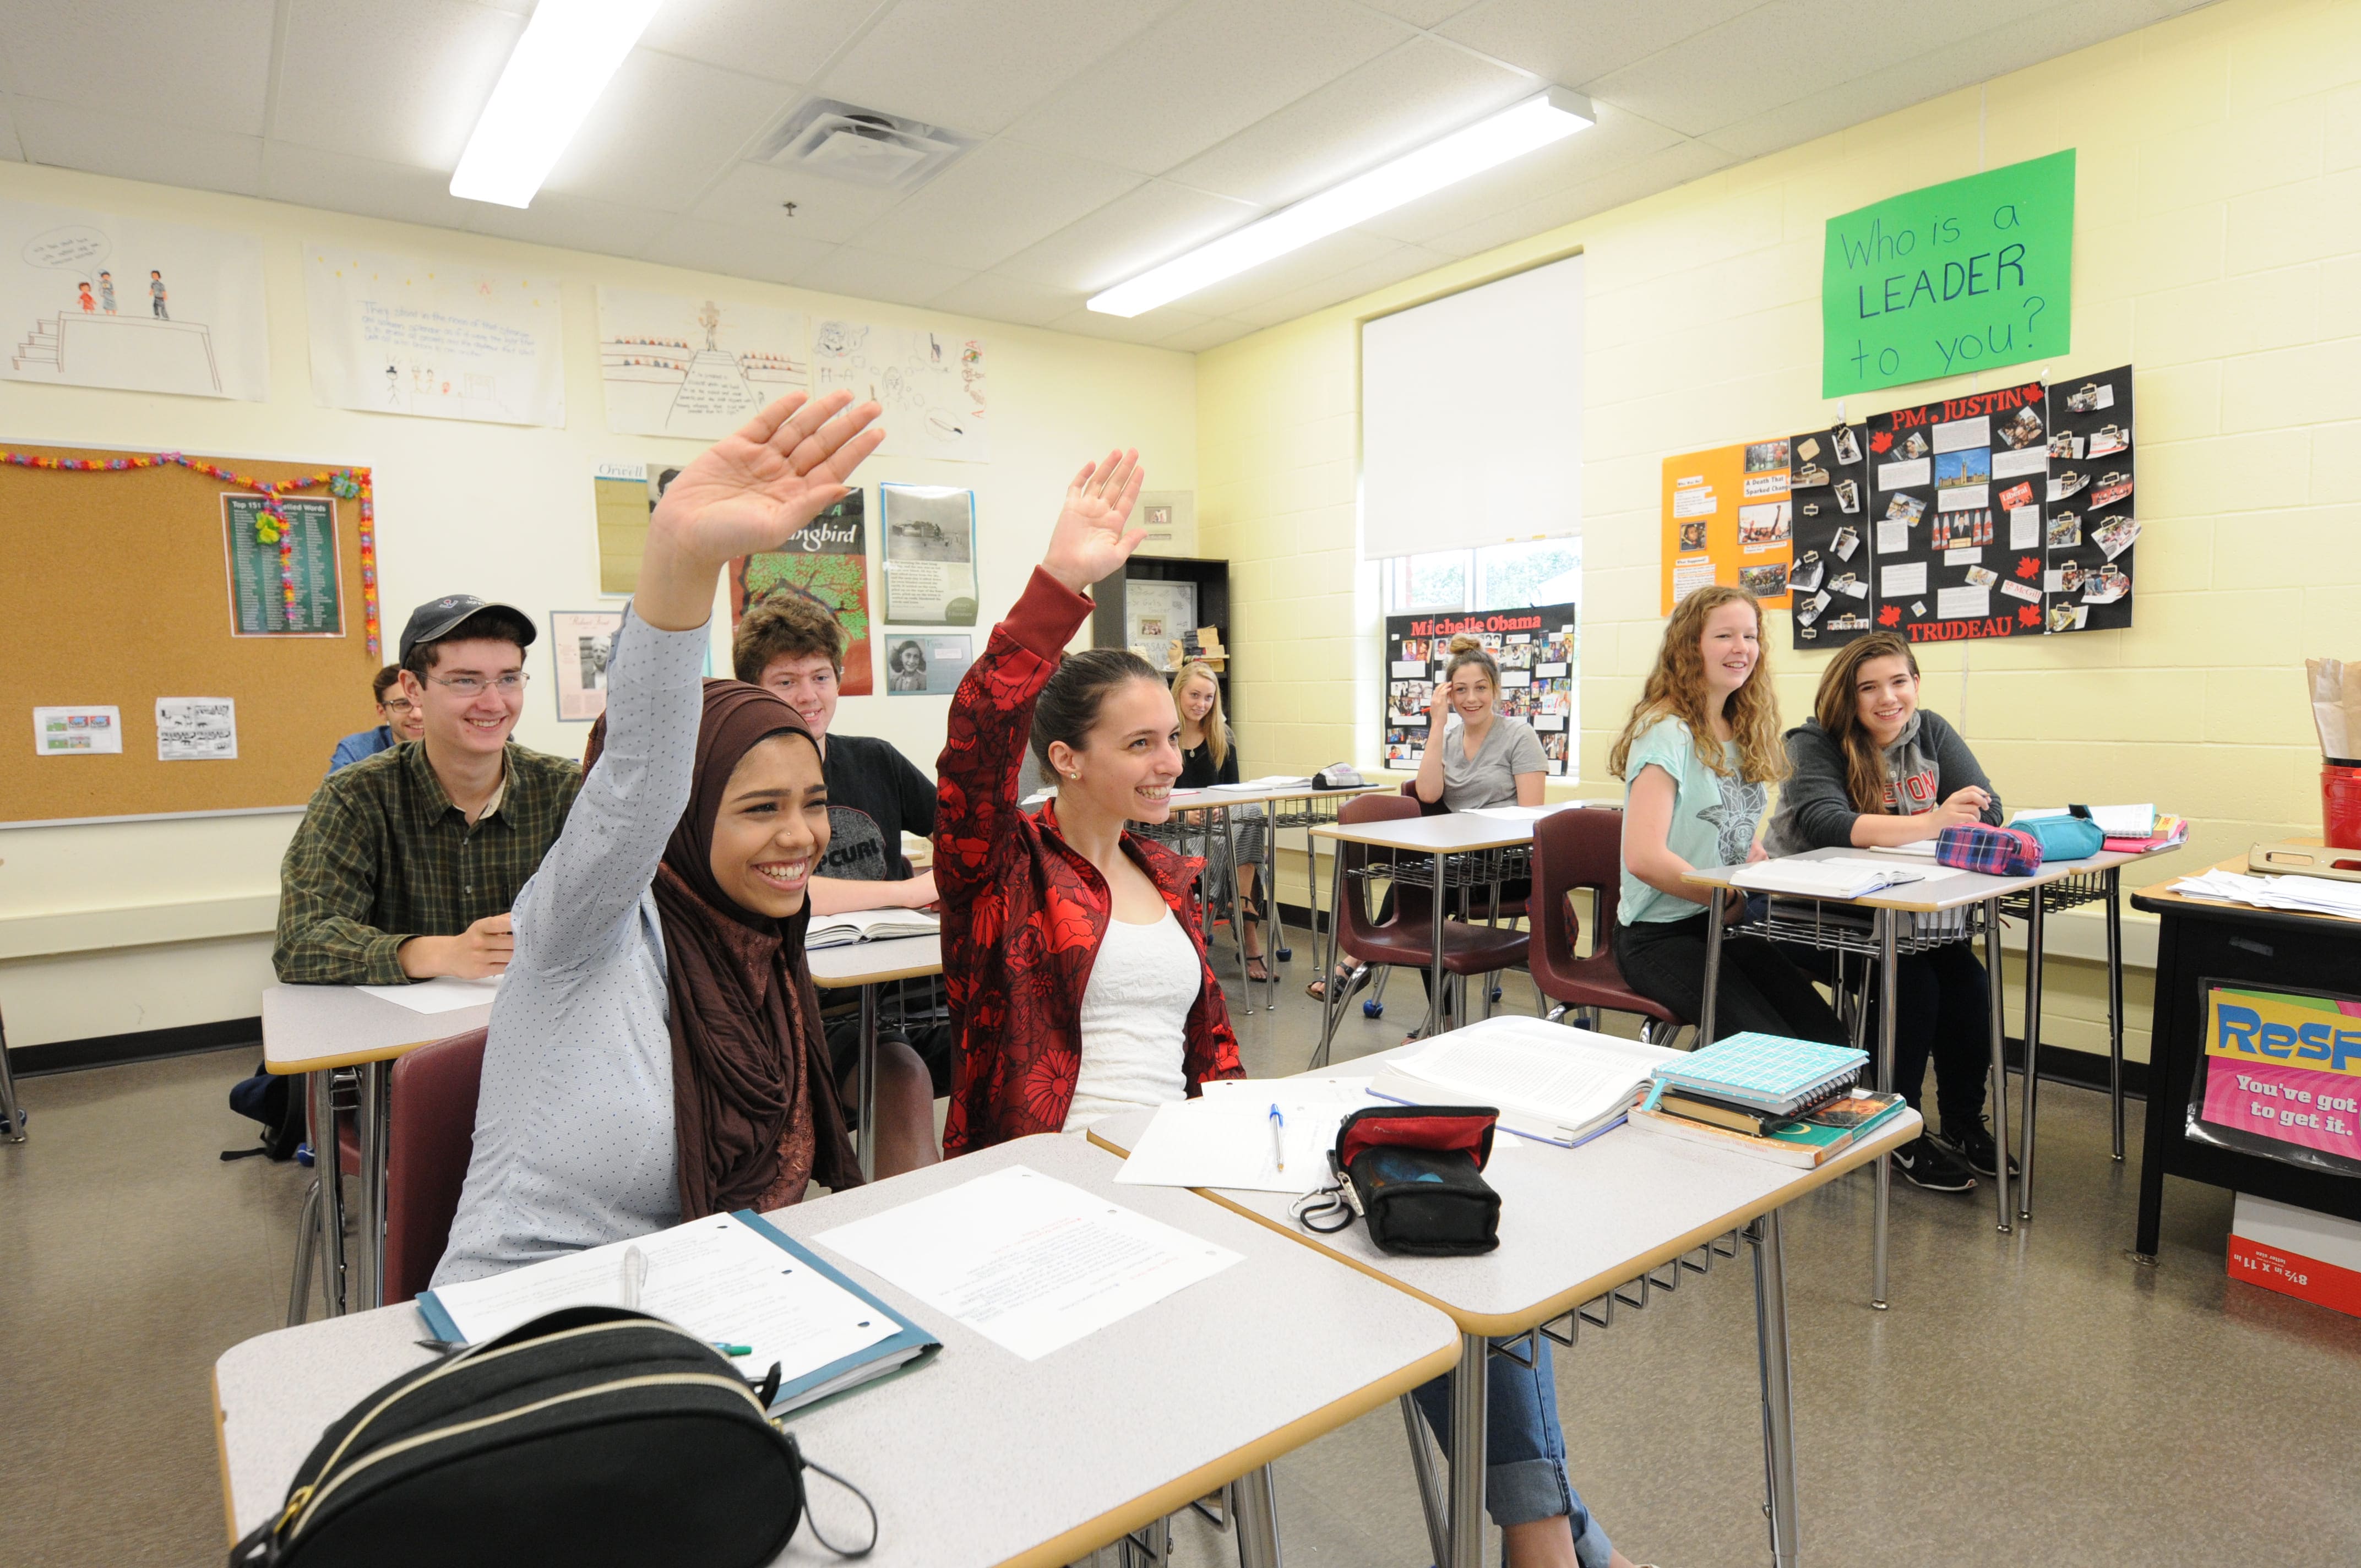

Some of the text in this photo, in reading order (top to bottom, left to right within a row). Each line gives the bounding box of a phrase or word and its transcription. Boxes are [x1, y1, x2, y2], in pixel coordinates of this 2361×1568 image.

[1841, 205, 2020, 270] Who is a
[1859, 243, 2026, 319] LEADER
[357, 300, 389, 318] They
[1850, 296, 2045, 379] to you?
[1943, 388, 2023, 423] JUSTIN
[599, 464, 643, 477] Orwell
[1746, 487, 1770, 496] Sparked
[2001, 485, 2028, 502] Liberal
[232, 500, 247, 509] Top
[830, 504, 842, 516] A
[2014, 584, 2041, 599] McGill
[1411, 615, 1541, 636] Michelle Obama
[1907, 616, 2013, 643] TRUDEAU
[1883, 769, 1937, 804] ETON
[2236, 1075, 2358, 1113] You've got
[2251, 1102, 2353, 1136] to get it.
[2234, 1254, 2242, 1262] in
[2244, 1257, 2257, 1270] 11
[2269, 1255, 2286, 1265] letter
[2274, 1266, 2282, 1275] in
